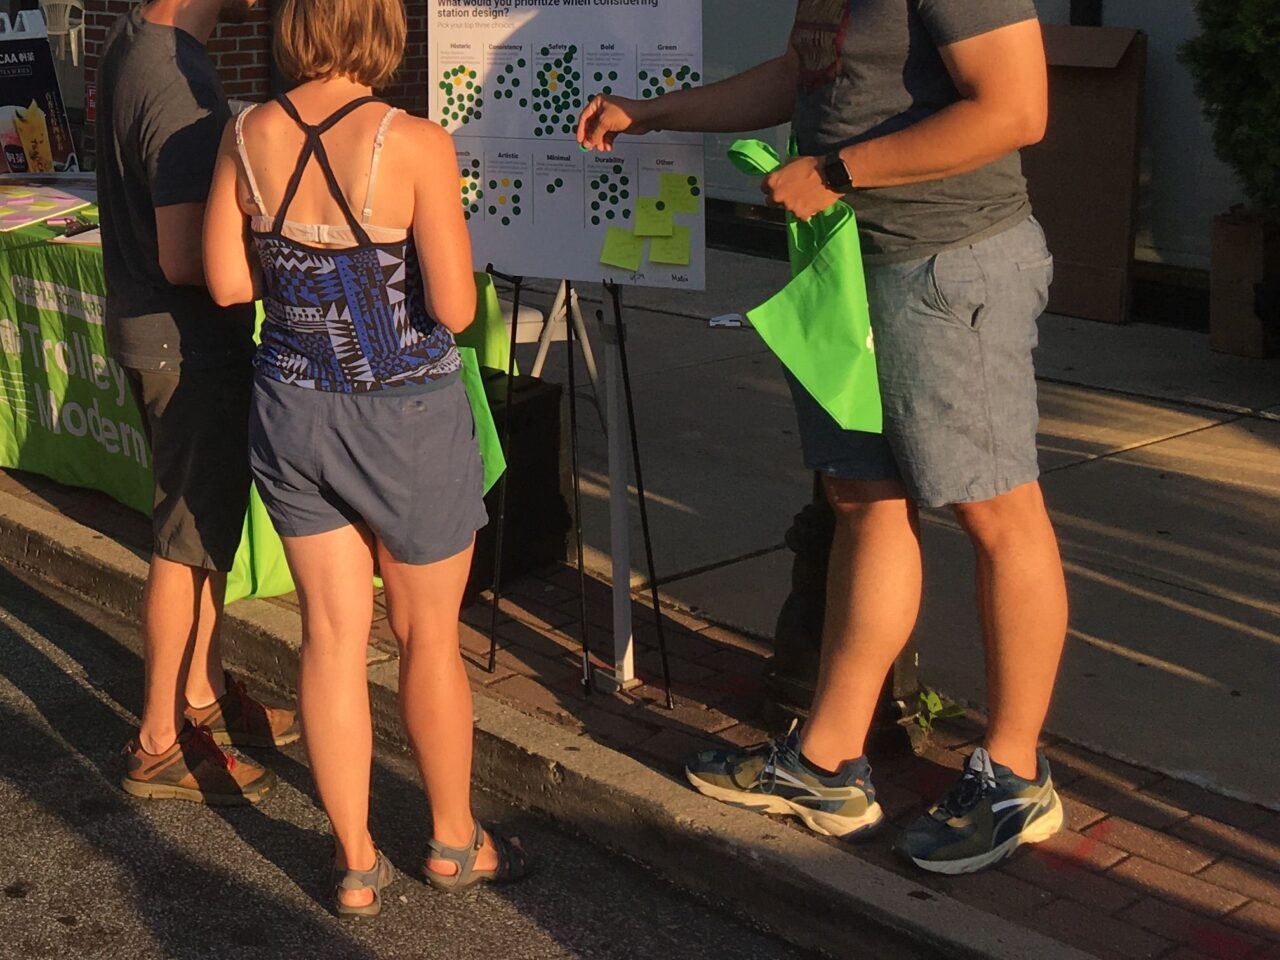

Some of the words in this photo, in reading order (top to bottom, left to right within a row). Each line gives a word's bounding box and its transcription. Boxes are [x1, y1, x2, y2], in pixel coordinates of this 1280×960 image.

[437, 8, 470, 18] station
[471, 7, 509, 20] design?
[464, 22, 474, 30] top
[548, 43, 567, 52] Safety
[595, 156, 625, 164] Durability
[56, 292, 104, 317] FORWARD
[22, 322, 125, 407] Trolley
[34, 383, 148, 468] Modern
